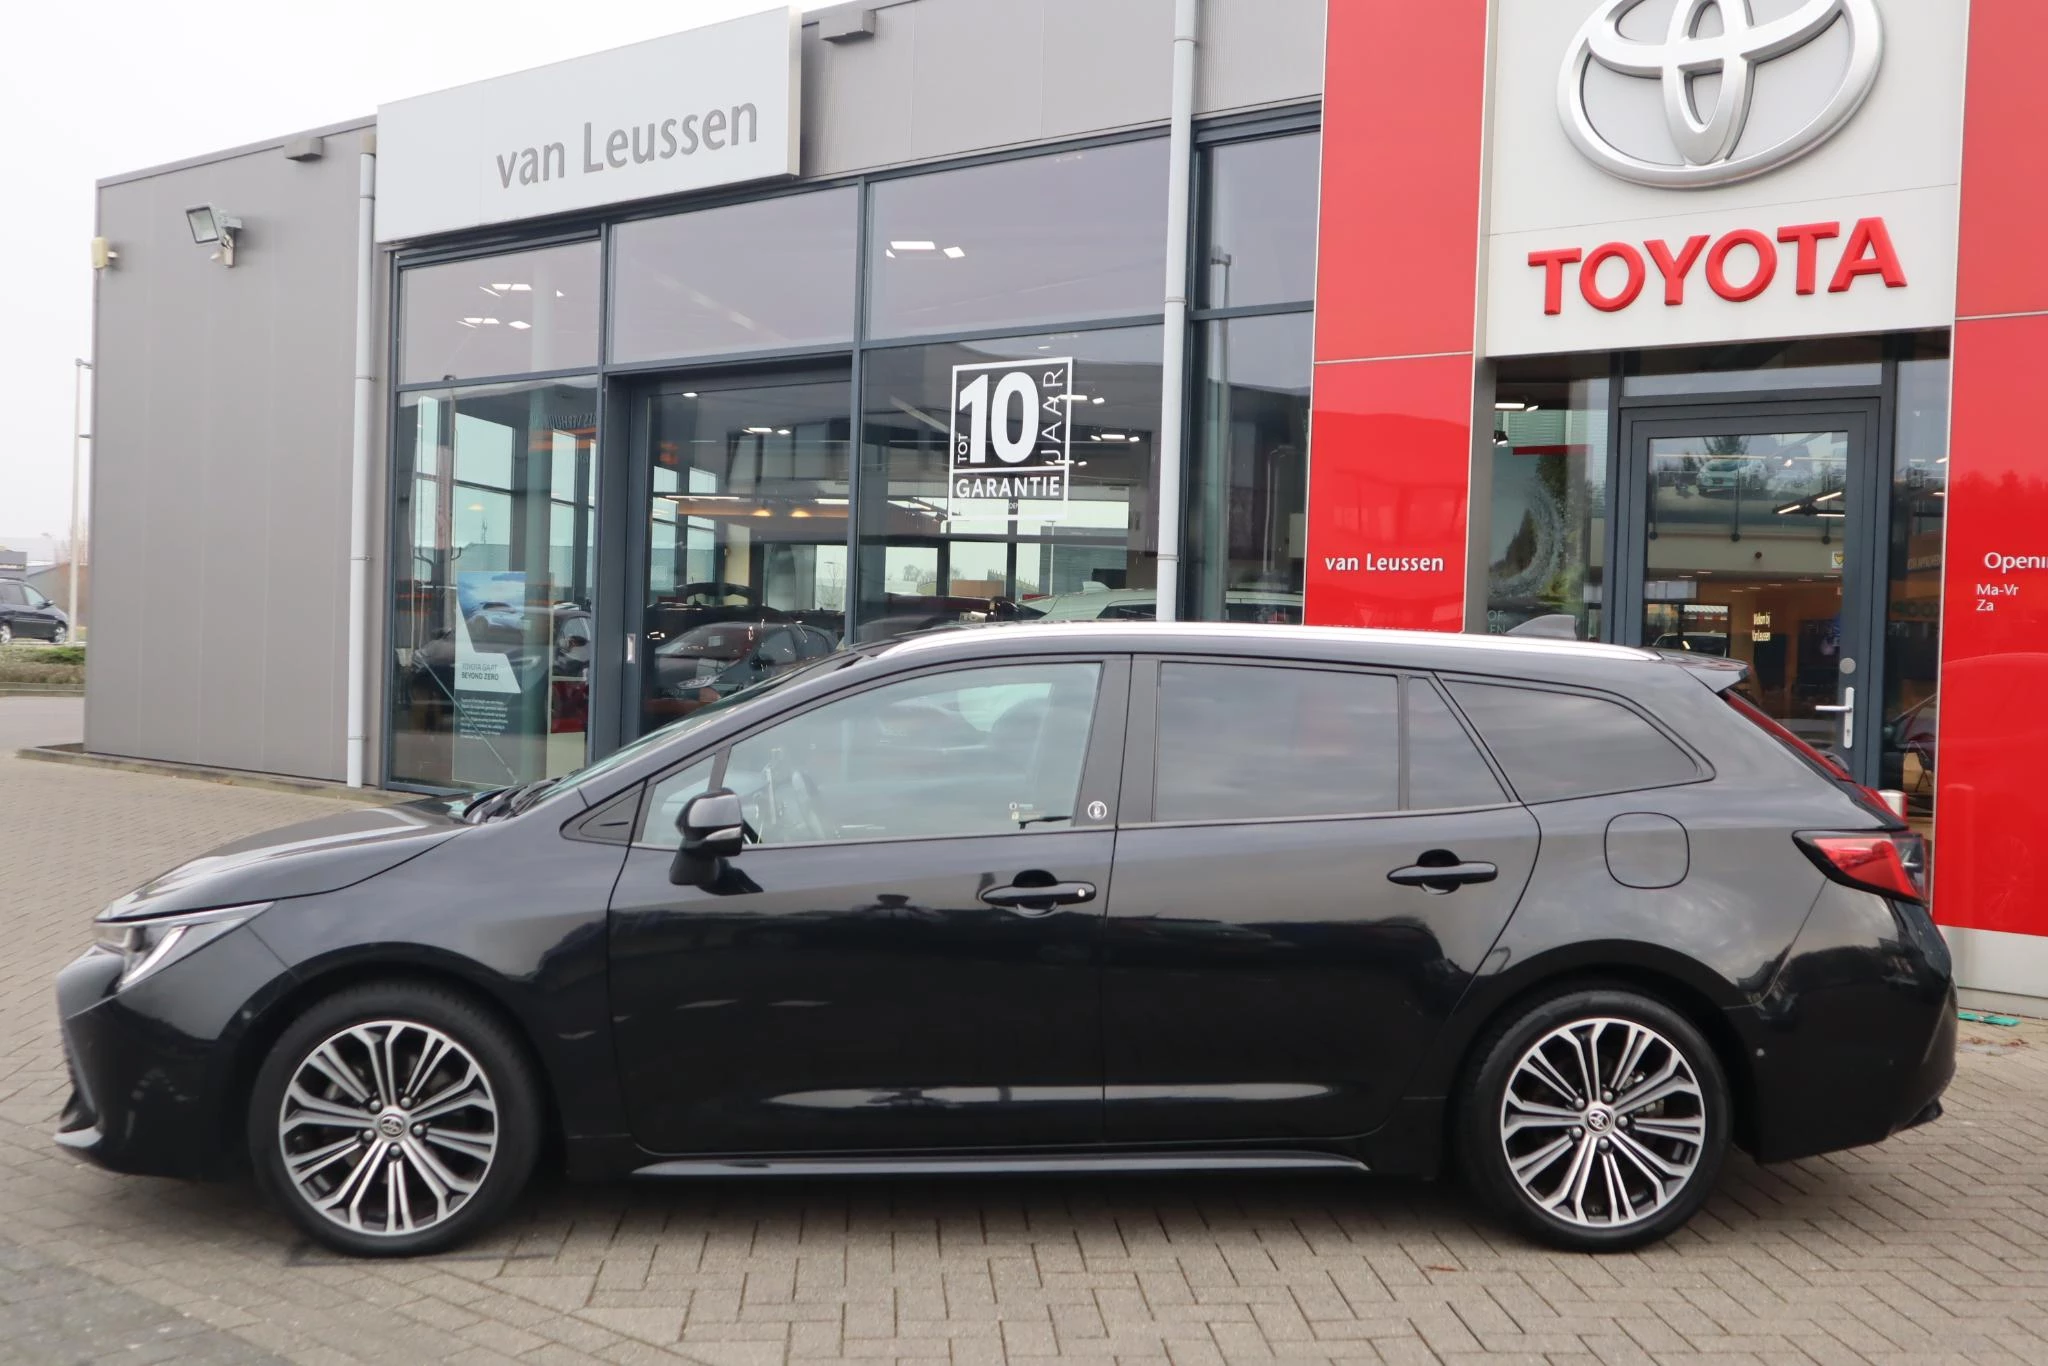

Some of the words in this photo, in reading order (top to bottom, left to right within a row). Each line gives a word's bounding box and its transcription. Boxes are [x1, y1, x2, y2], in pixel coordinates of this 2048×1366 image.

[496, 140, 565, 189] van
[583, 102, 758, 174] Leussen
[1527, 216, 1908, 316] TOYOTA
[959, 371, 1040, 464] 10
[1041, 368, 1064, 462] JAAR
[958, 433, 969, 464] TOT
[956, 475, 1060, 498] GARANTIE
[1324, 556, 1359, 571] van
[1366, 552, 1444, 572] Leussen
[1976, 583, 2019, 596] Ma-Vr
[1975, 598, 1994, 612] Za
[461, 671, 484, 680] BEYOND
[484, 673, 499, 681] ZERO
